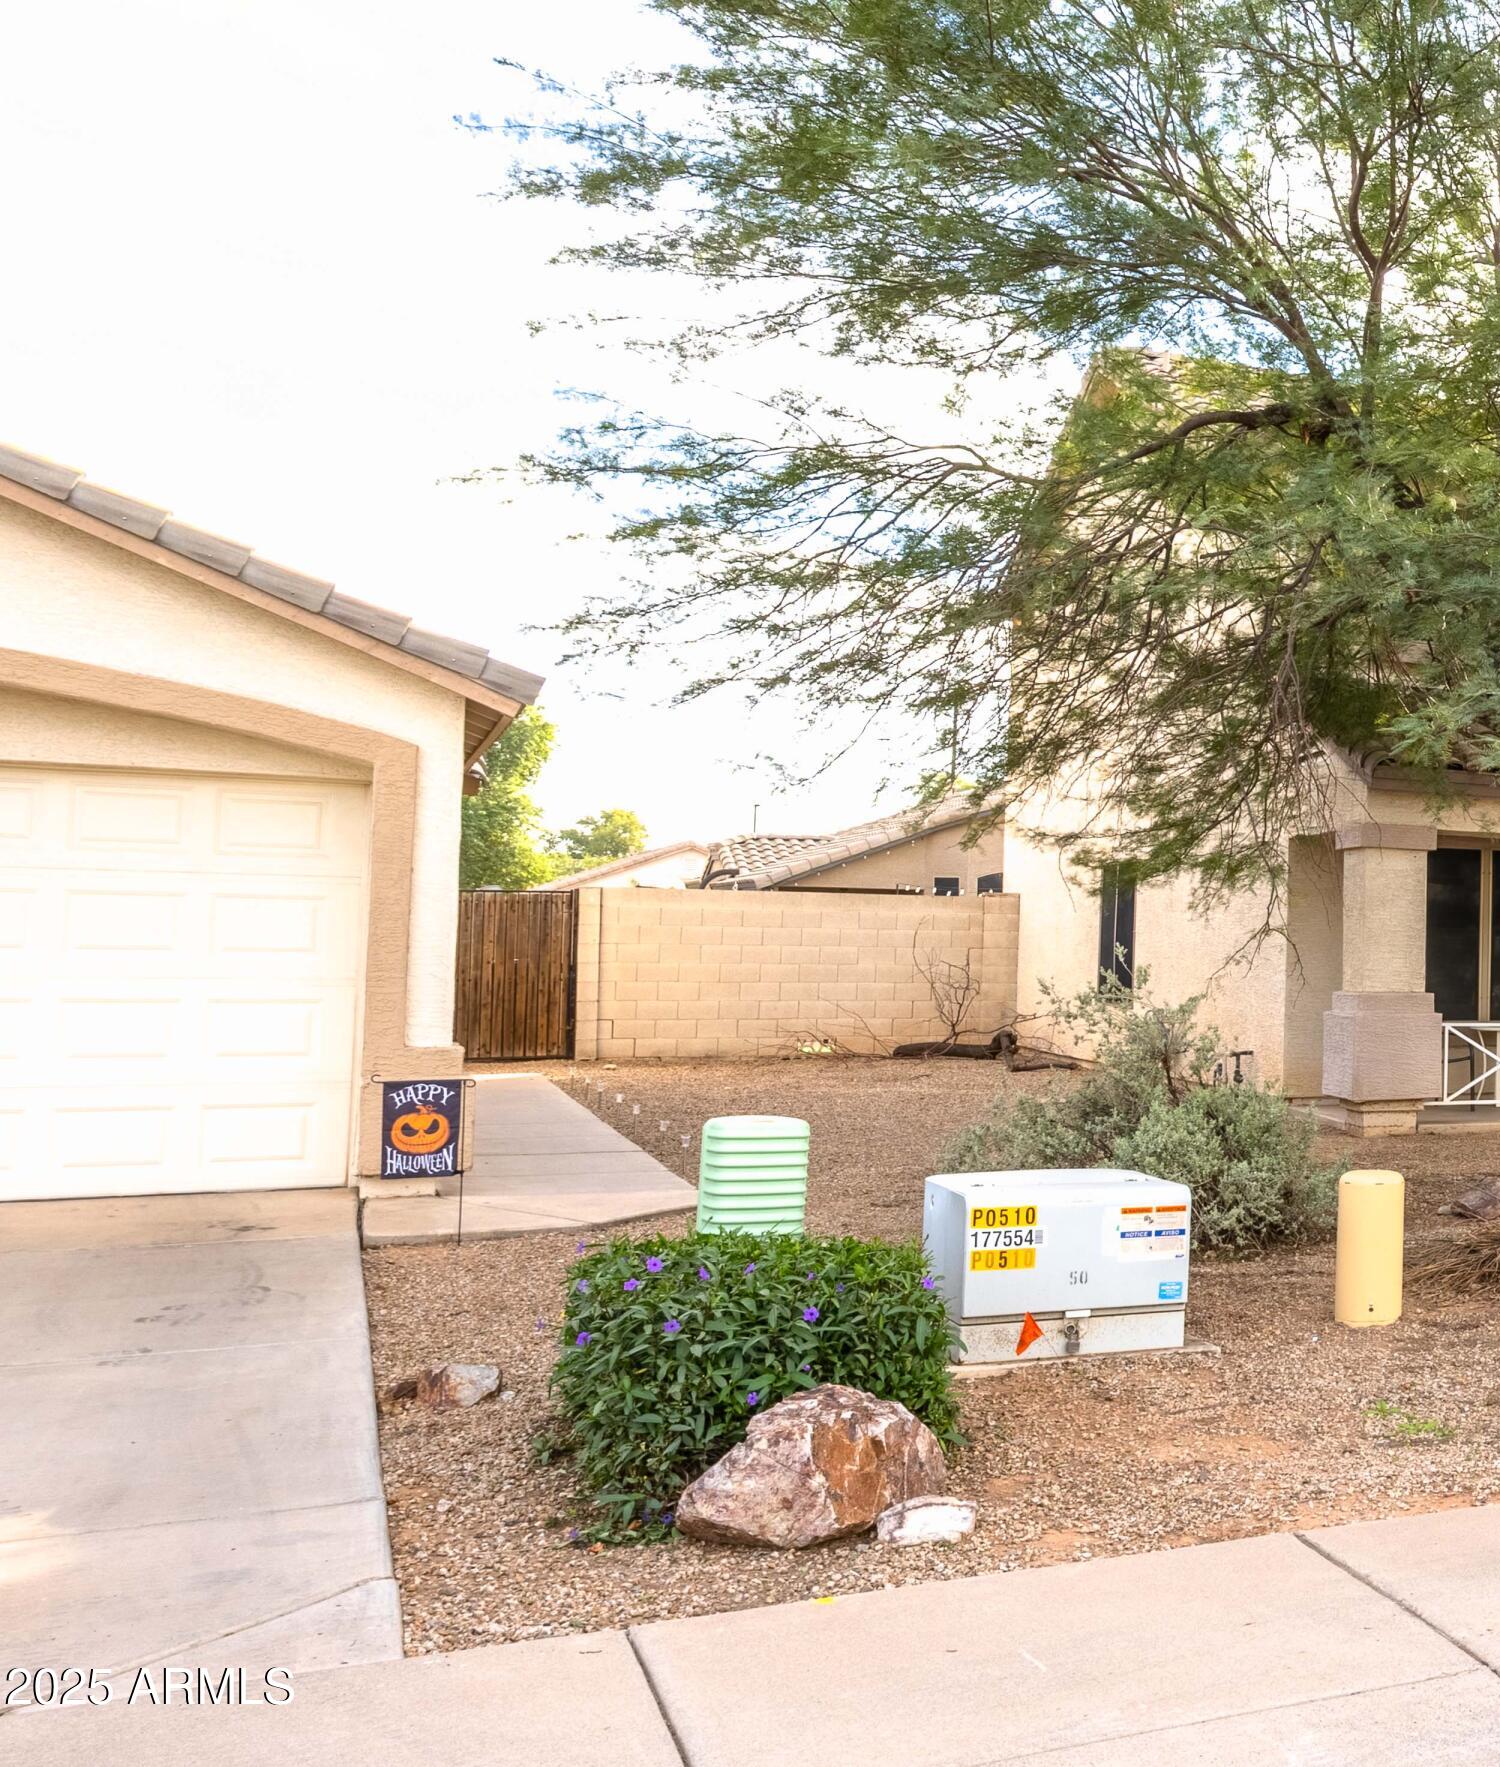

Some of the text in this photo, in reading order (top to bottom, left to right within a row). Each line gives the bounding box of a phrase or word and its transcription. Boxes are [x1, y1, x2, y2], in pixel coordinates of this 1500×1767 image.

[388, 1083, 456, 1110] HAPPY
[384, 1142, 456, 1176] HALLOWEEN
[972, 1206, 1036, 1227] P0510
[970, 1229, 1034, 1248] 177554
[971, 1250, 1034, 1270] P0510
